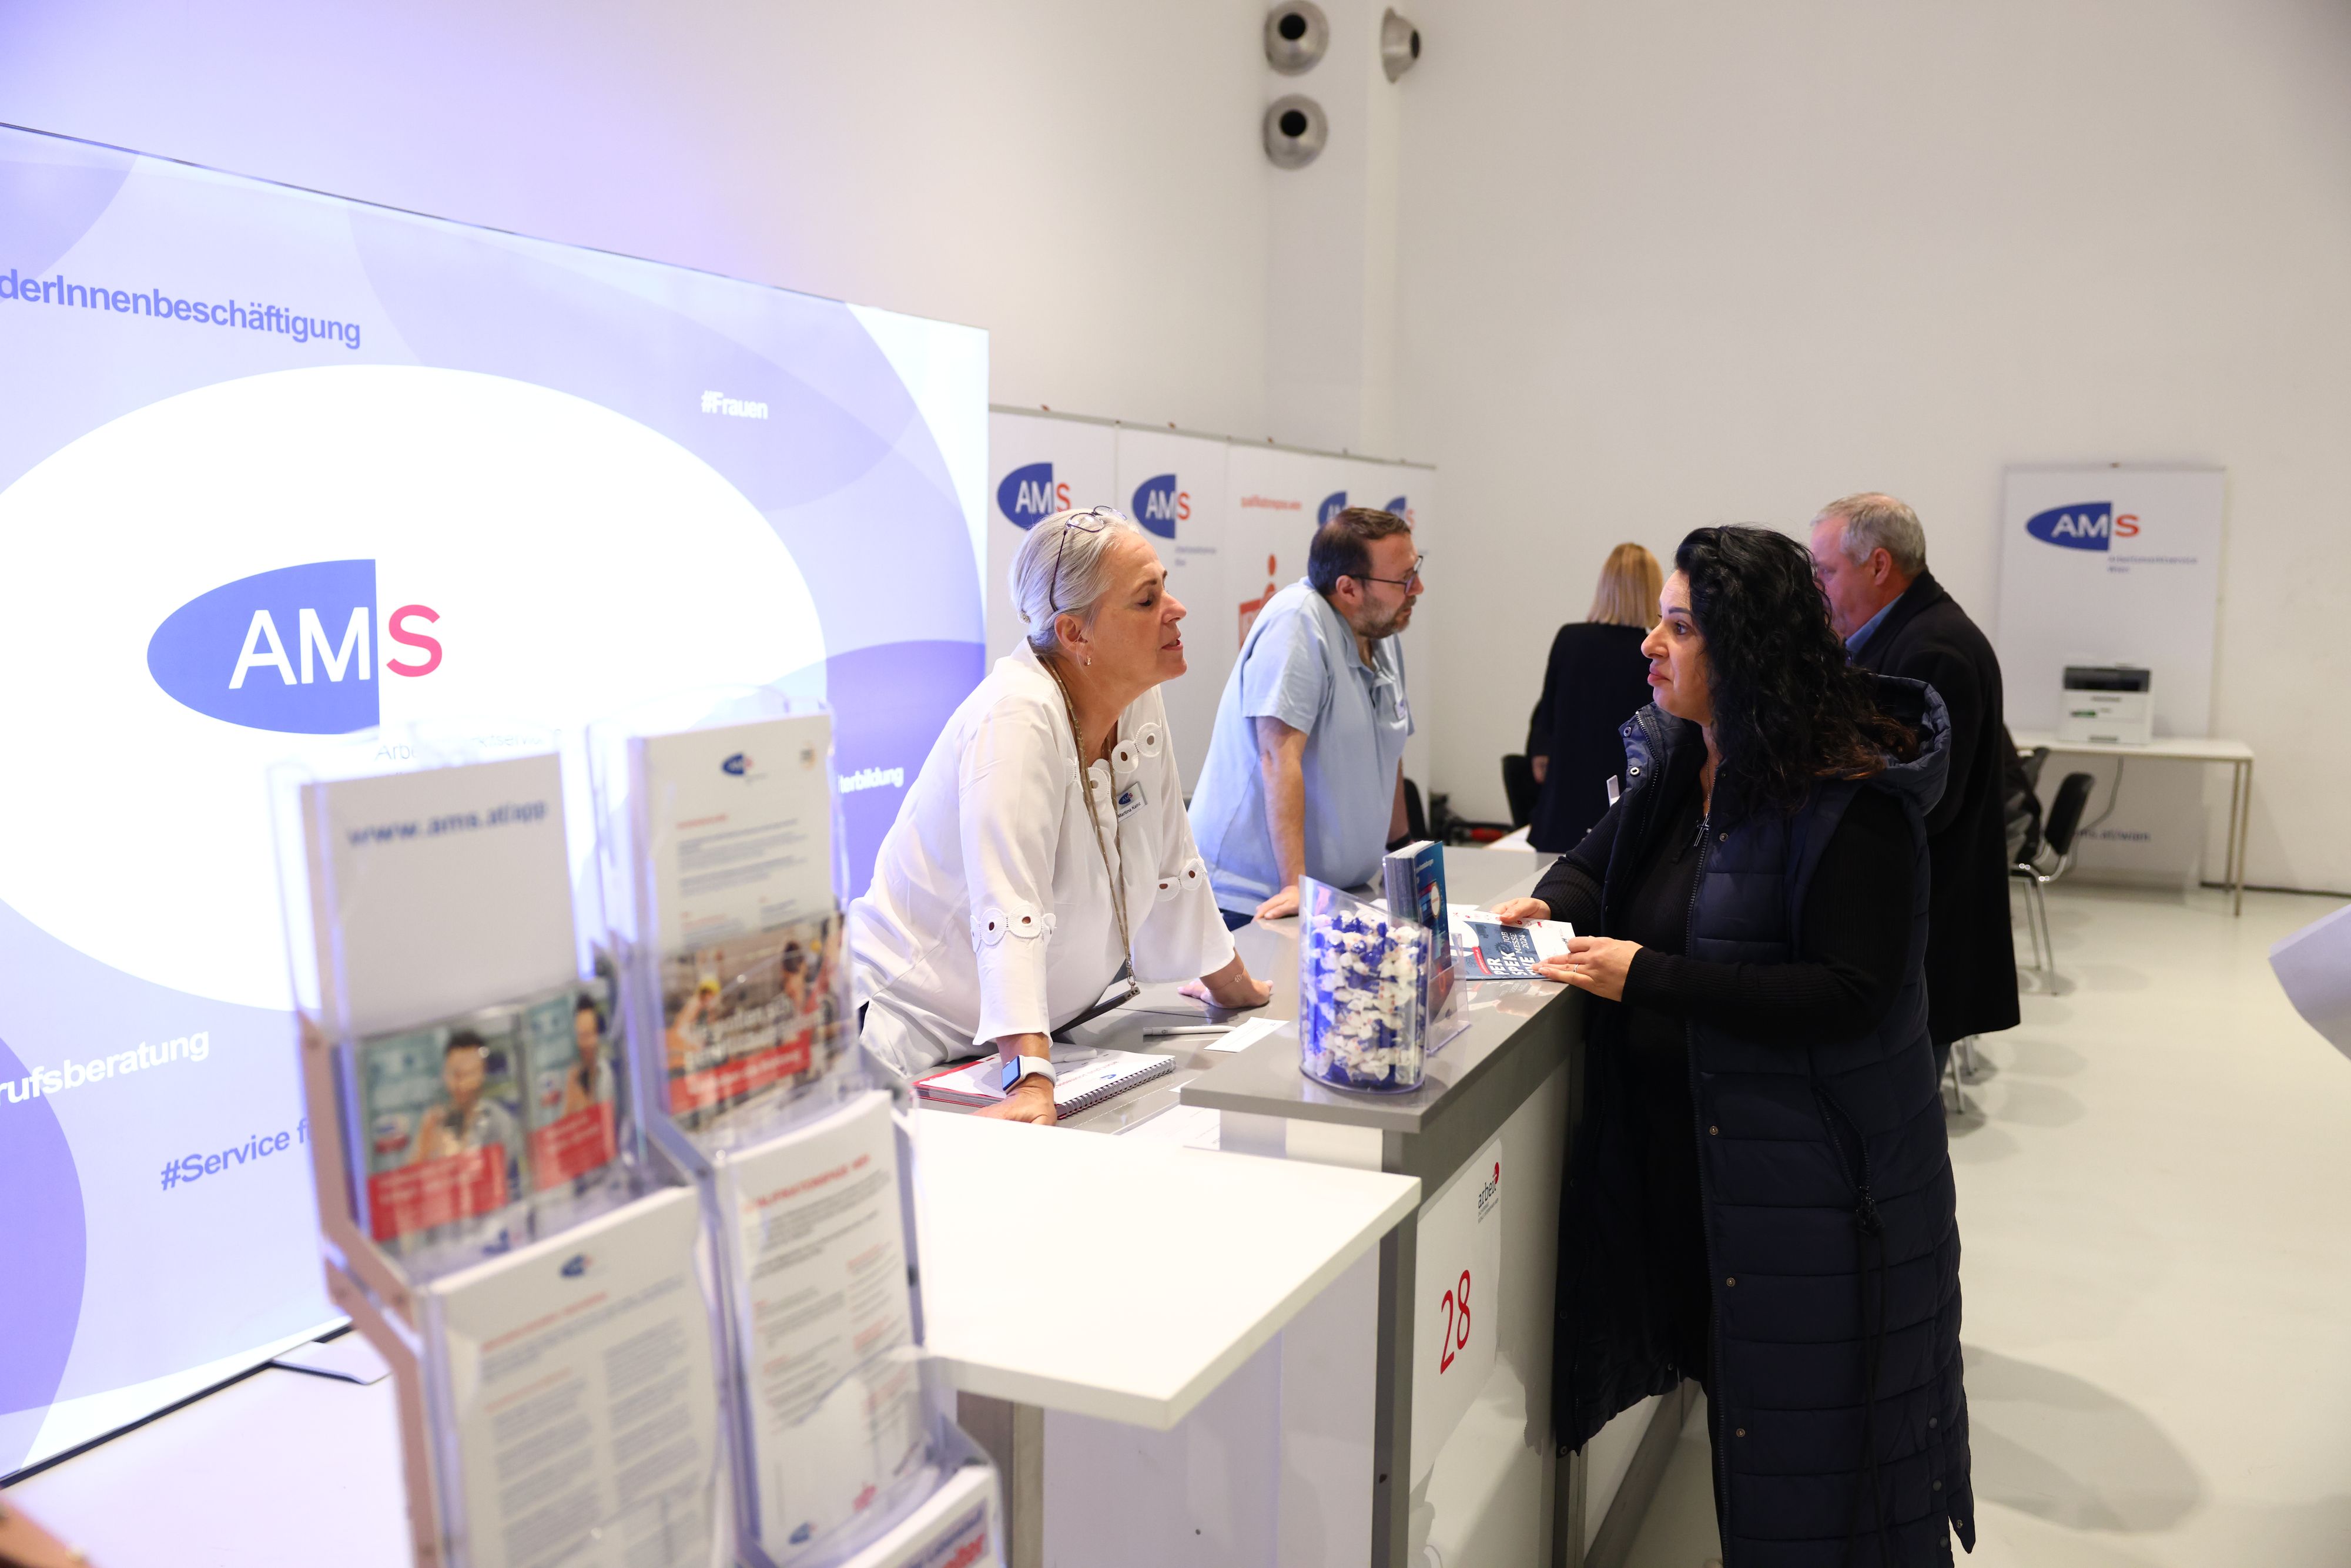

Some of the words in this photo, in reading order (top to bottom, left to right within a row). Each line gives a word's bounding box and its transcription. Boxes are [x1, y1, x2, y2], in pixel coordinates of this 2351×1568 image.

[701, 390, 768, 419] #Frauen
[1015, 480, 1071, 513] AMS
[1146, 490, 1190, 520] AMS
[2051, 514, 2139, 538] AMS
[229, 604, 443, 689] AMS
[1117, 808, 1132, 818] Martina
[1501, 932, 1511, 943] JOB
[1510, 933, 1522, 953] MESSE
[1519, 934, 1529, 949] 2024
[1487, 958, 1510, 975] PER
[1501, 951, 1525, 976] SPEK
[161, 1131, 290, 1191] #Service
[1440, 1269, 1471, 1375] 28
